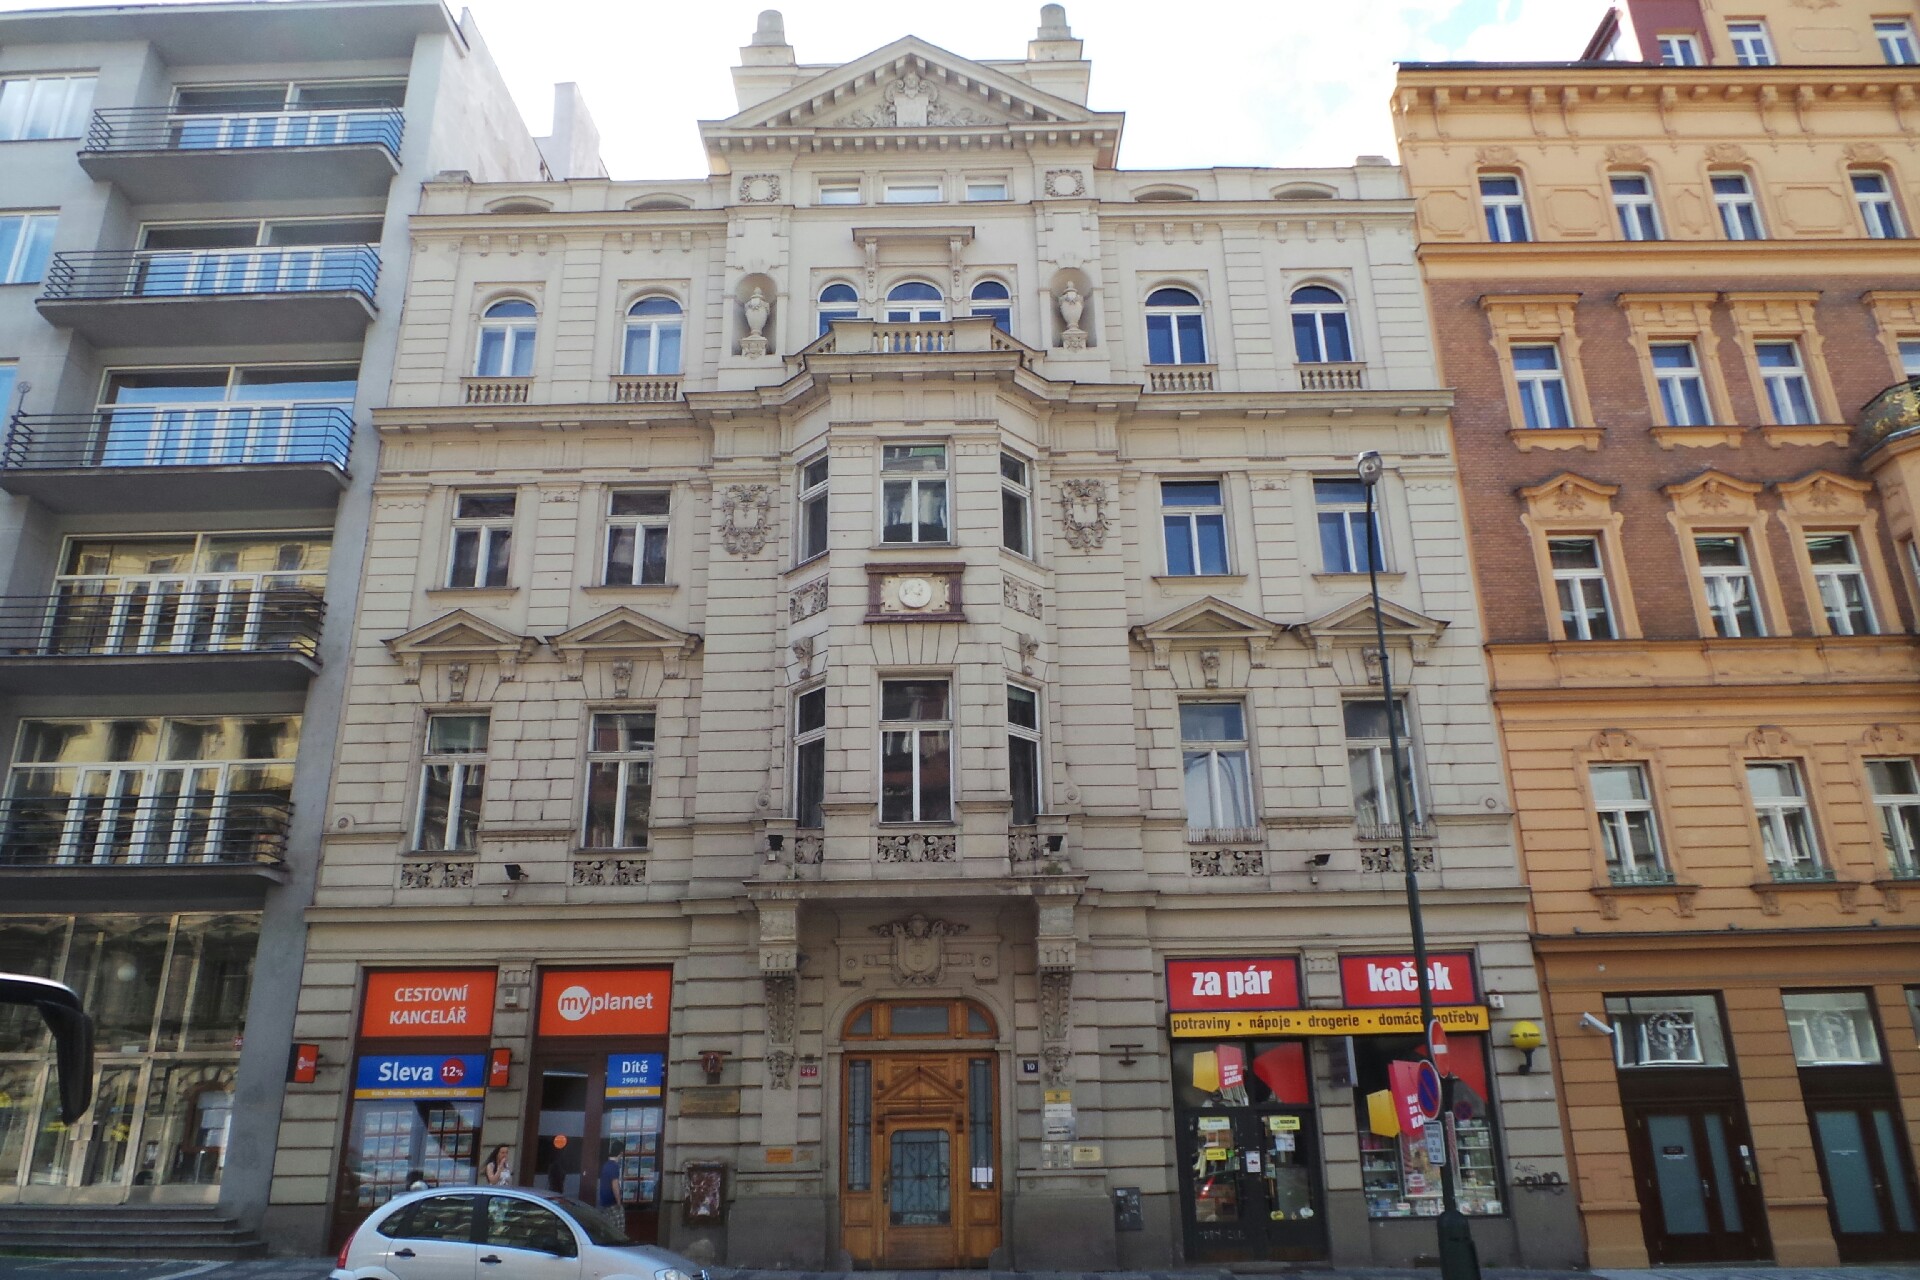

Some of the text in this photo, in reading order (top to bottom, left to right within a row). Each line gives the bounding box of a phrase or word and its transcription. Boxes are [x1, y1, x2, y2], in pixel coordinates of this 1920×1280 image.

[1191, 965, 1273, 998] za pár
[394, 984, 469, 1002] CESTOVNÍ
[560, 992, 654, 1015] myplanet
[389, 1006, 467, 1025] KANCELÁŘ
[1173, 1017, 1231, 1032] potraviny
[1249, 1015, 1291, 1030] nápoje
[1308, 1014, 1360, 1029] drogerie
[378, 1061, 464, 1082] Sleva 12%
[622, 1060, 649, 1074] Dítě
[1026, 1063, 1036, 1071] 10
